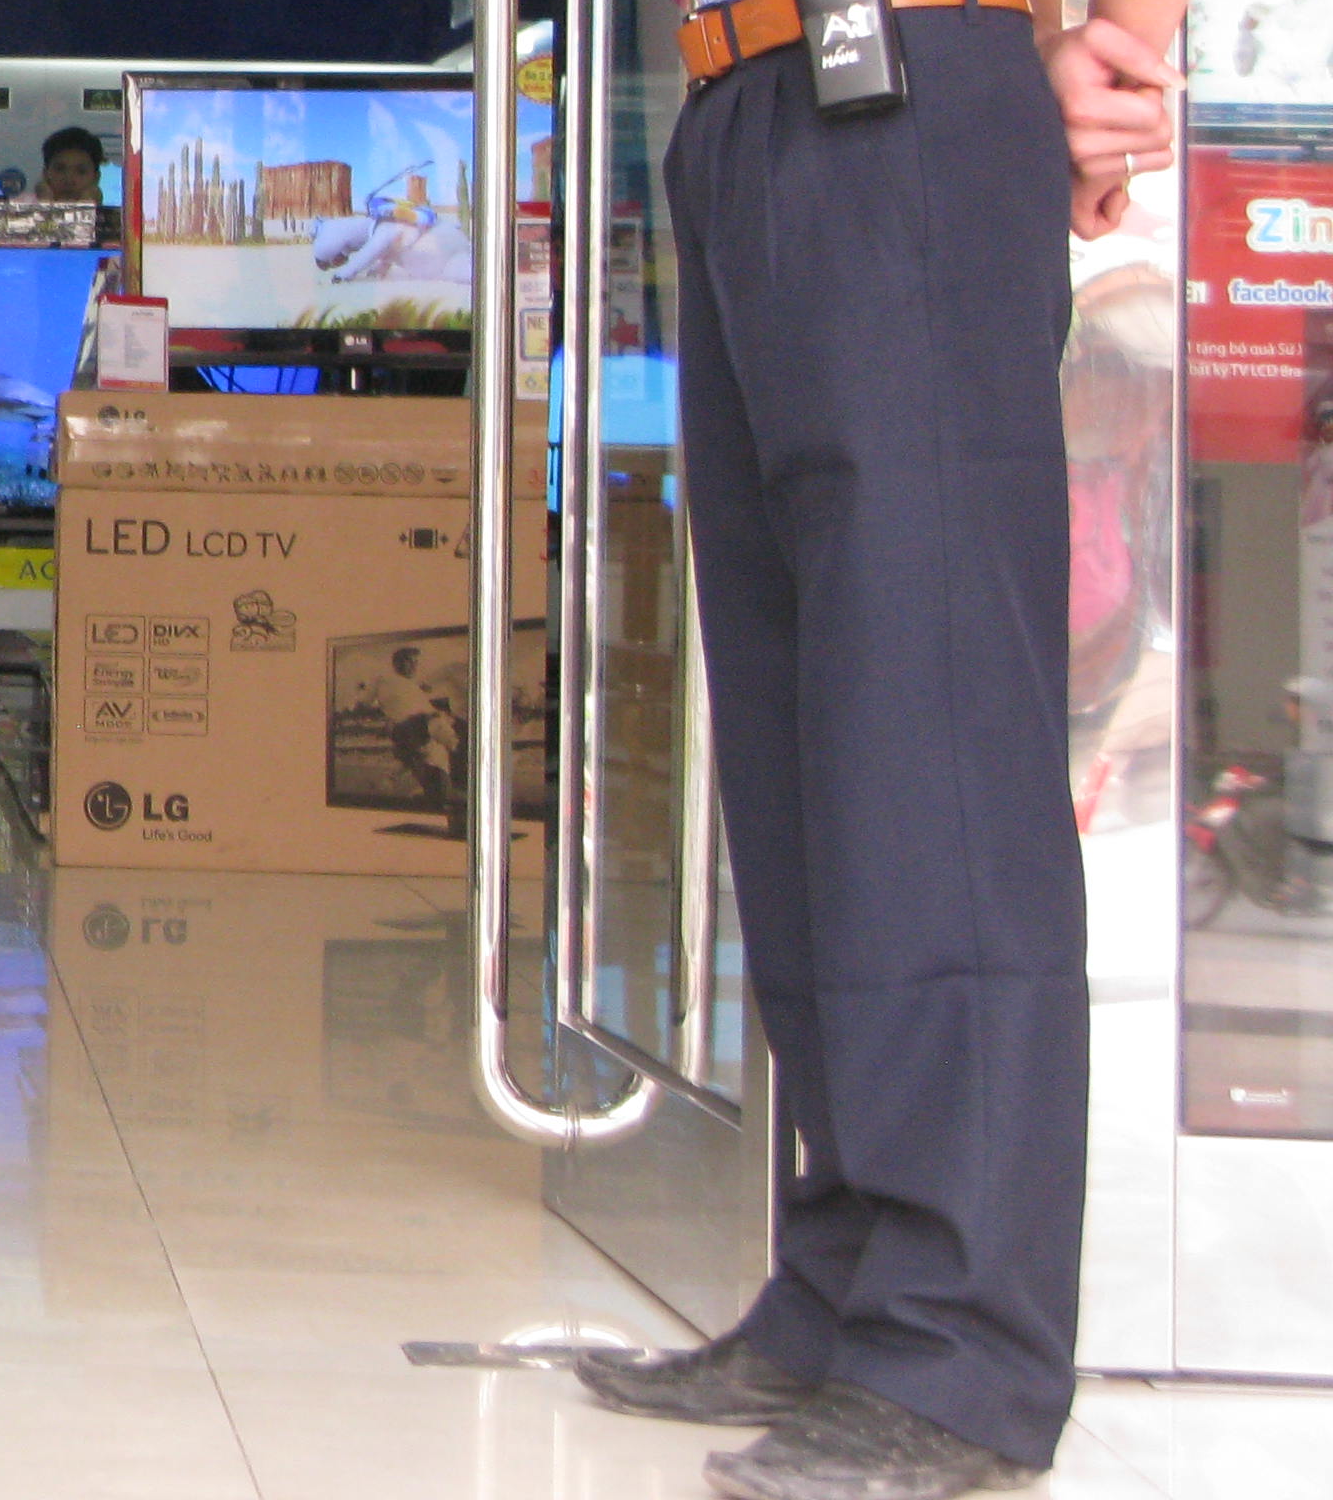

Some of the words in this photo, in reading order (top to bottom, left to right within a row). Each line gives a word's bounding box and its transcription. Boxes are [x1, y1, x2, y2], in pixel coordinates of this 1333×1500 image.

[1231, 279, 1331, 303] facebook
[1229, 363, 1251, 377] TV
[84, 518, 171, 558] LED
[185, 531, 248, 559] LCD
[255, 532, 297, 559] TV
[95, 701, 133, 720] AV
[142, 793, 190, 823] LG
[142, 828, 175, 842] Life's
[177, 829, 213, 844] Good
